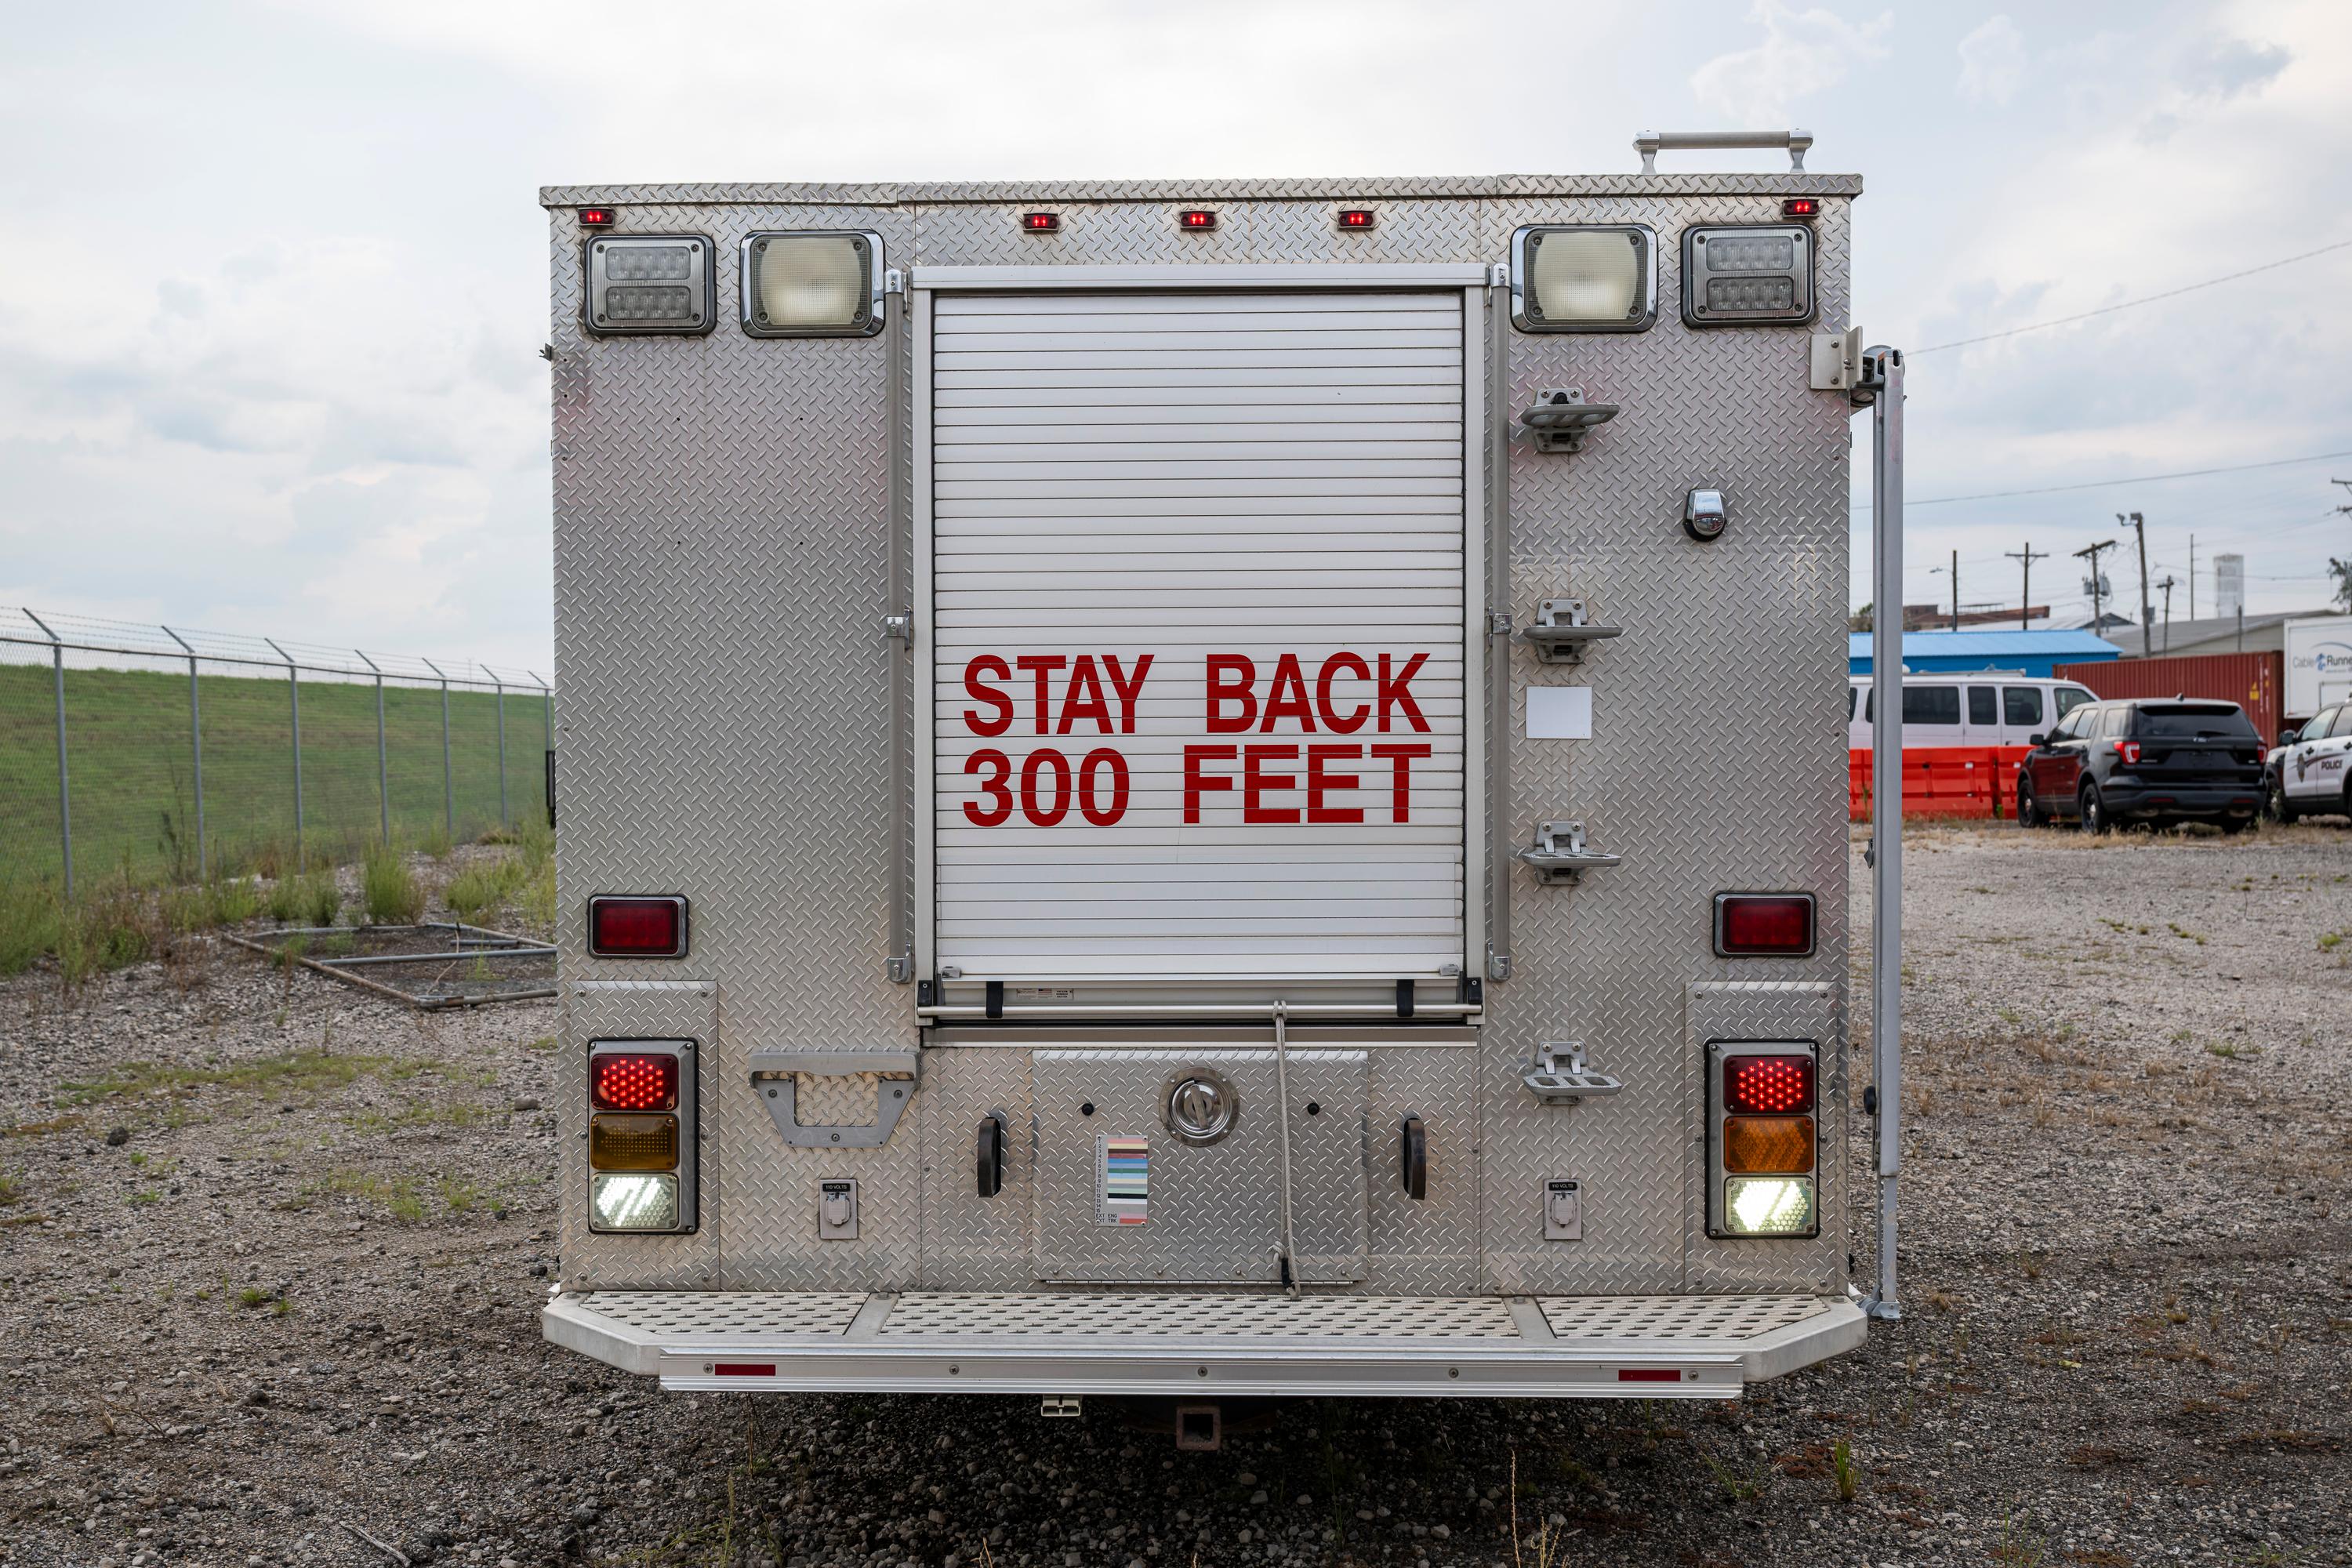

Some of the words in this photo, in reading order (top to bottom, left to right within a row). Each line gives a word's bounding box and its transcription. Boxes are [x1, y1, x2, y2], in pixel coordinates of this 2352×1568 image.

[964, 655, 1154, 736] STAY
[1207, 652, 1431, 734] BACK
[964, 748, 1129, 826] 300
[1184, 744, 1432, 824] FEET
